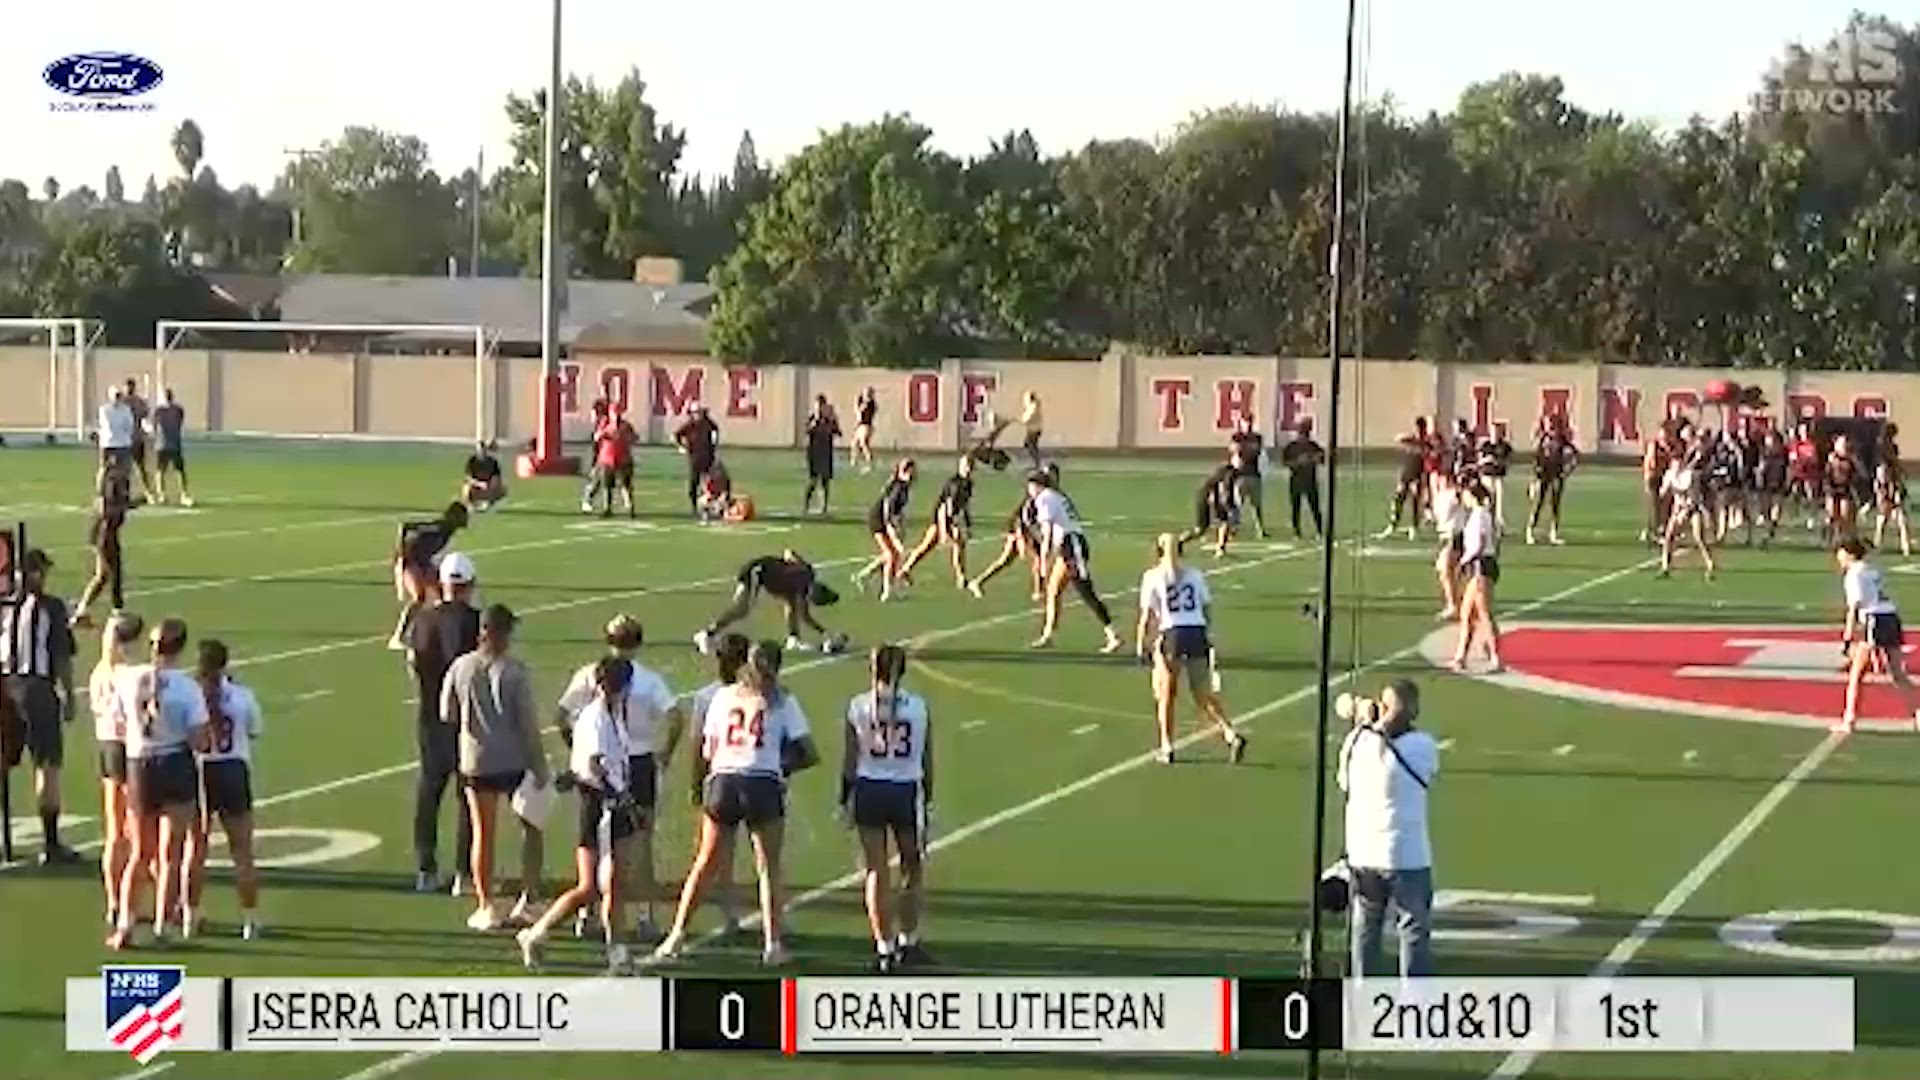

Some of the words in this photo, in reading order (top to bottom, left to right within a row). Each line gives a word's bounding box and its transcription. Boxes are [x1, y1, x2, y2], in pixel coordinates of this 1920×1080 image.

[558, 364, 760, 418] HOME
[908, 372, 997, 423] OF
[1153, 379, 1315, 432] THE
[1166, 584, 1197, 613] 23
[725, 706, 766, 748] 24
